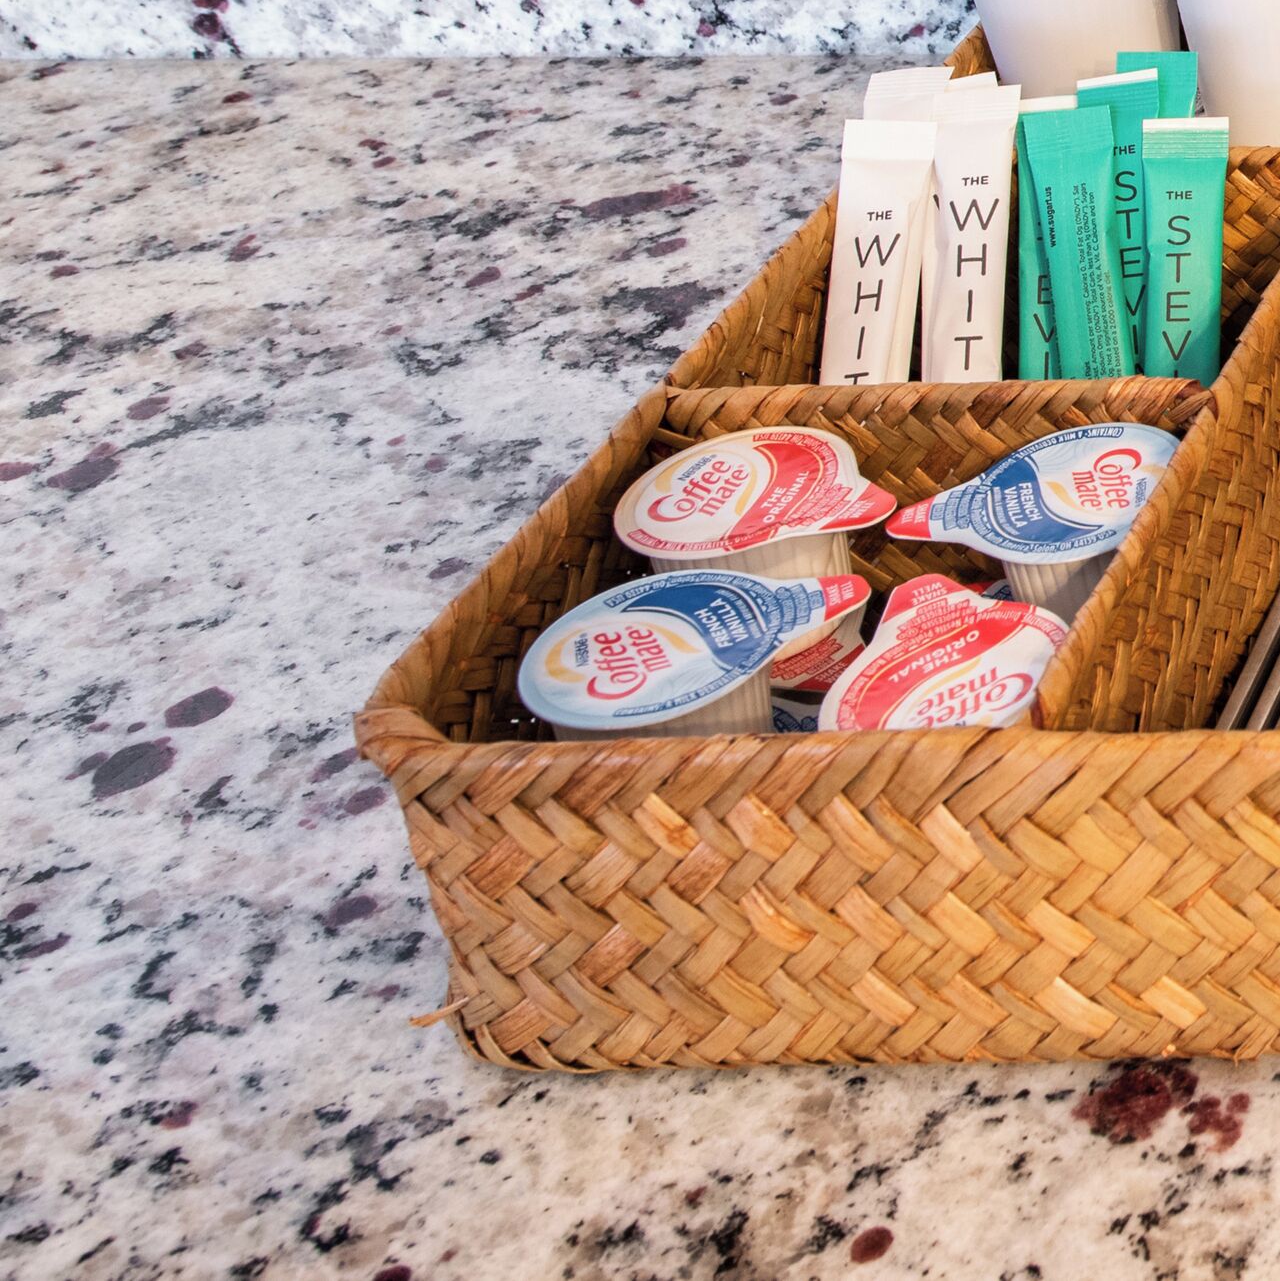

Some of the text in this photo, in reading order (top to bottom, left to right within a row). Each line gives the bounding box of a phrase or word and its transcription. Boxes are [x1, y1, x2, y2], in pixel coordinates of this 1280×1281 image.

[962, 176, 989, 186] THE
[1080, 182, 1088, 203] Sugars
[1166, 191, 1192, 200] THE
[867, 210, 893, 221] THE
[1045, 187, 1057, 248] www.sugart.us
[1075, 225, 1083, 235] 0g
[1081, 272, 1089, 298] Calories
[1162, 215, 1192, 378] STEV
[1099, 291, 1107, 312] source
[1095, 334, 1103, 349] 0mg
[1101, 313, 1112, 346] significant
[1112, 336, 1118, 345] on
[1098, 350, 1106, 375] Sodium
[1113, 346, 1121, 366] based
[1058, 432, 1077, 442] MILK
[647, 460, 731, 522] Coffee
[1072, 471, 1102, 508] mate
[1094, 448, 1142, 508] Coffee
[698, 469, 749, 517] mate
[760, 486, 787, 508] THE
[763, 470, 809, 523] ORIGINAL
[1003, 486, 1026, 528] VANILLA
[1017, 480, 1043, 522] FRENCH
[912, 582, 942, 596] WELL
[912, 588, 947, 606] SHAKE
[694, 609, 733, 648] FRENCH
[710, 597, 750, 643] VANILLA
[628, 629, 672, 672] mate
[888, 629, 980, 682] ORIGINAL
[922, 651, 962, 673] THE
[587, 631, 647, 700] Coffee
[917, 667, 997, 715] mate
